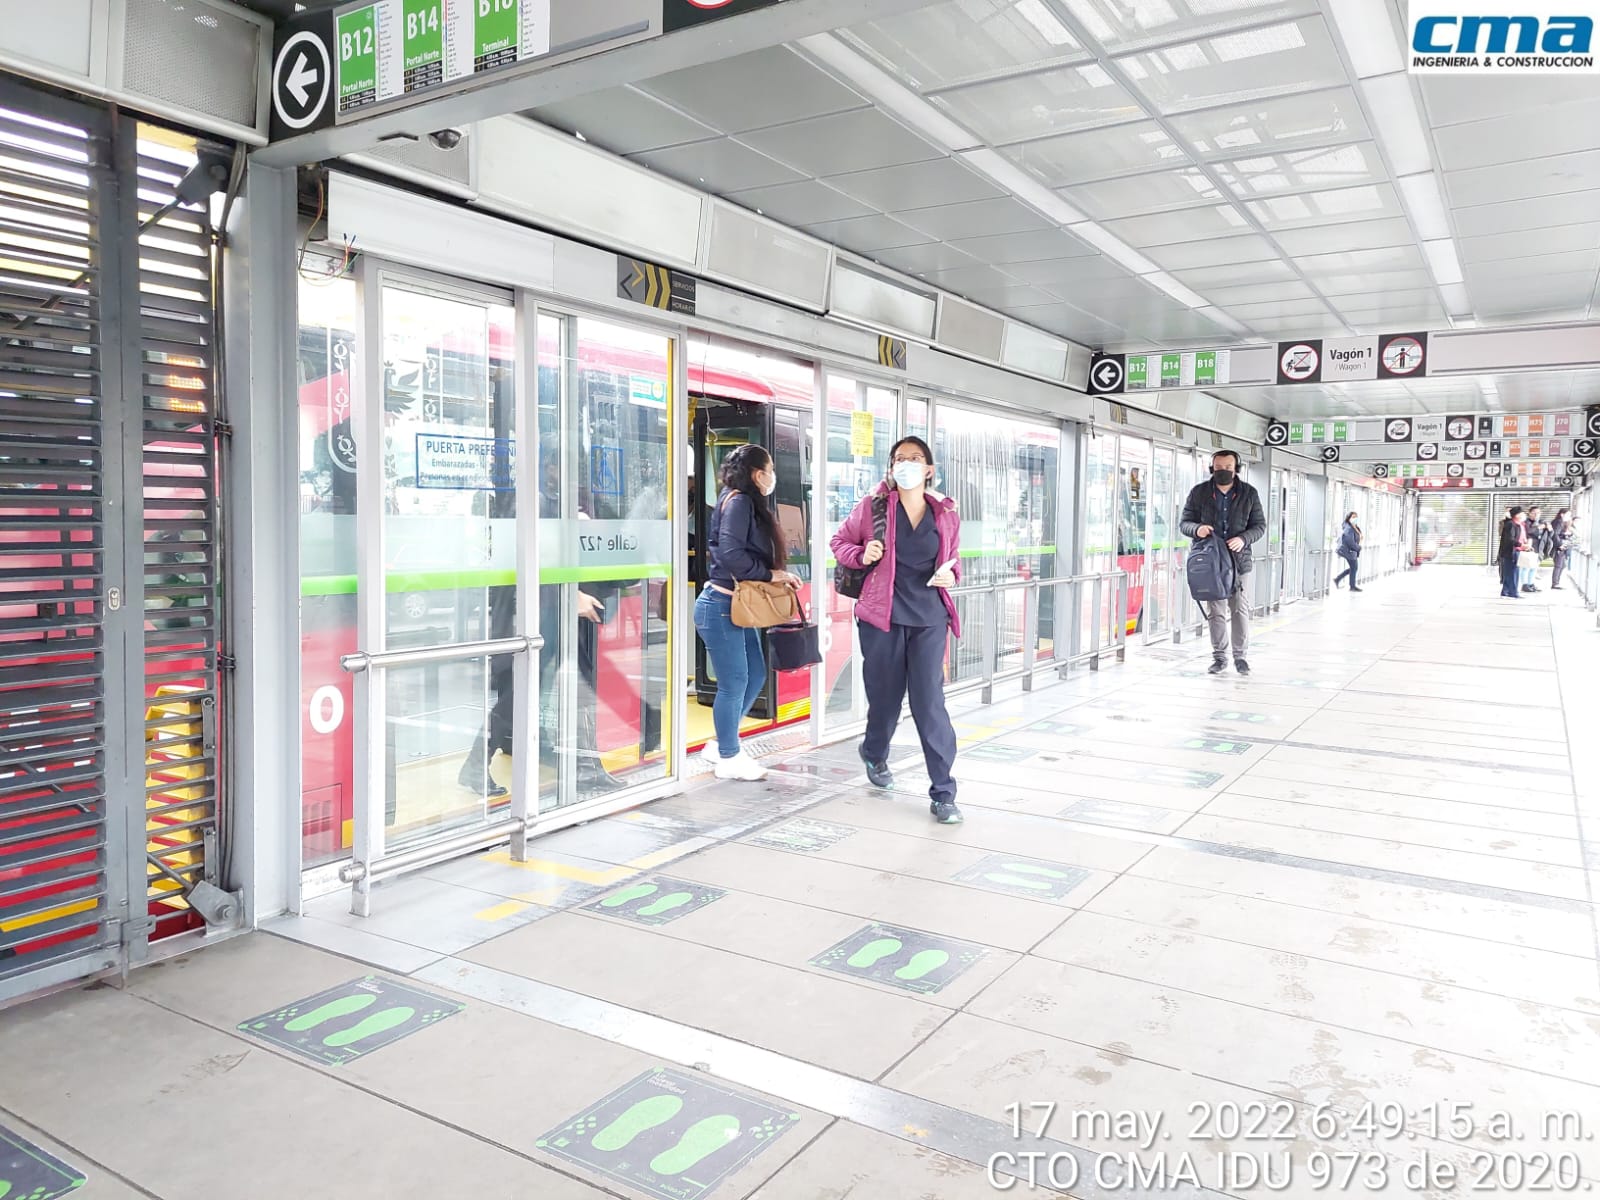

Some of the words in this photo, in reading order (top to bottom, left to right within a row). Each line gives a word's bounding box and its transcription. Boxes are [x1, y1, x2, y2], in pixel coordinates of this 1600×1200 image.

[407, 6, 439, 40] B14
[341, 26, 373, 62] B12
[482, 36, 510, 53] Terminal
[406, 53, 423, 67] Portal
[423, 50, 440, 62] Norte
[342, 81, 358, 94] Portal
[358, 79, 374, 91] Norte
[1330, 347, 1364, 362] Vagón
[1366, 347, 1372, 358] 1
[1129, 362, 1146, 373] B12
[1163, 361, 1179, 371] B14
[1197, 359, 1214, 369] B18
[426, 440, 466, 454] PUERTA
[431, 459, 475, 469] Embarazadas
